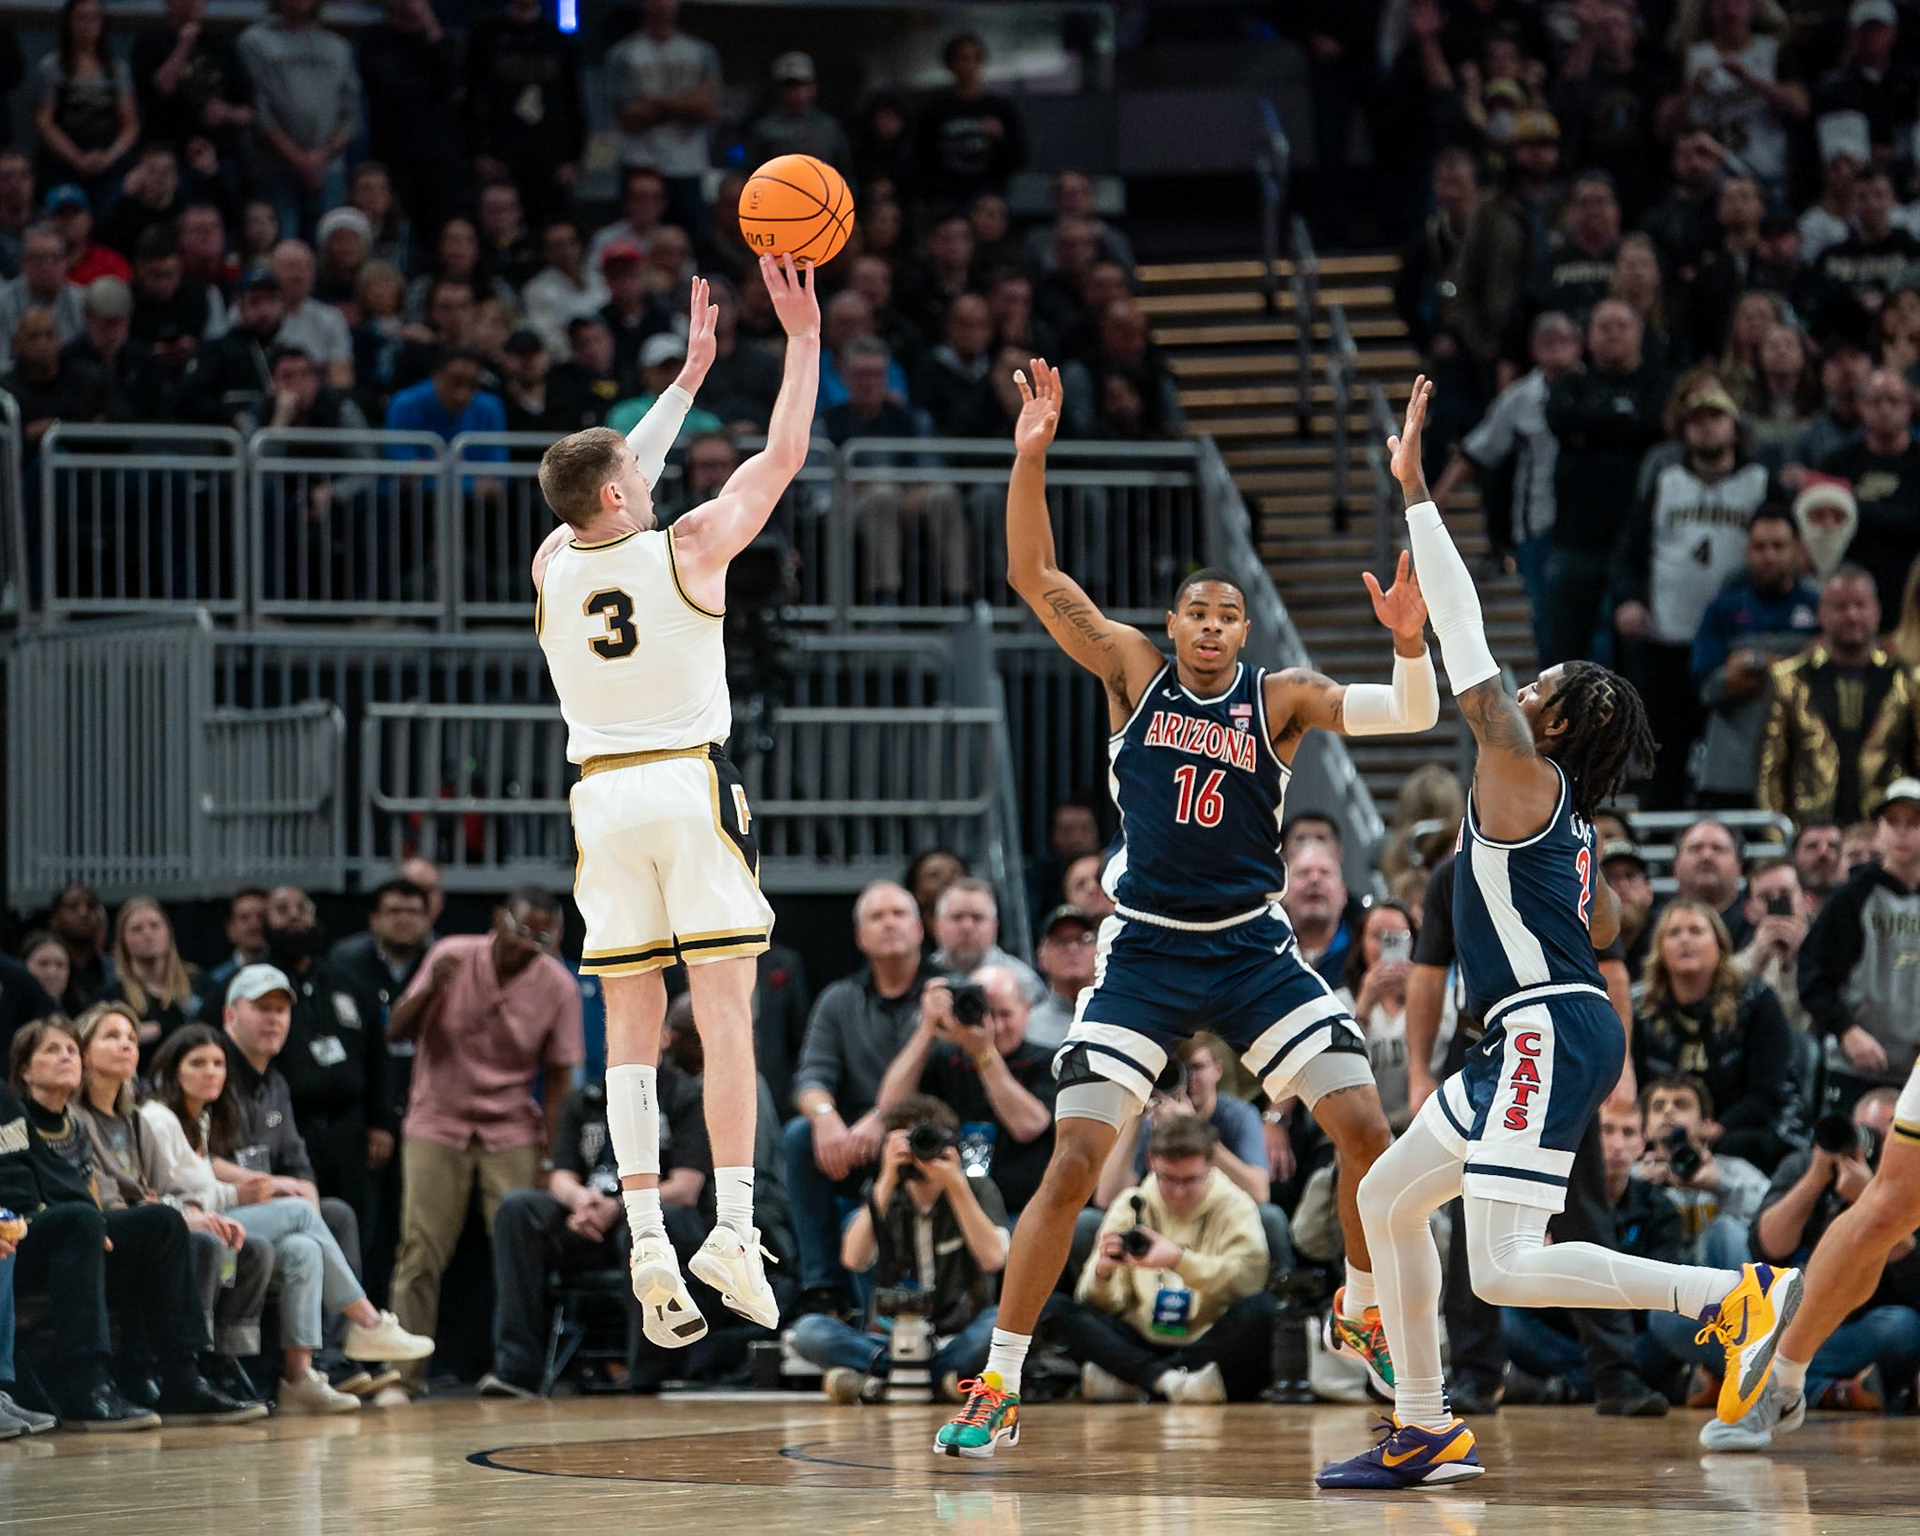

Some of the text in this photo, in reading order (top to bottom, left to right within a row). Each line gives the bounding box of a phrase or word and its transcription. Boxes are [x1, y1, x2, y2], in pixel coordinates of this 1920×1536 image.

[1691, 536, 1714, 567] 4
[582, 586, 641, 661] 3
[1143, 711, 1257, 773] ARIZONA
[730, 783, 753, 835] P
[1174, 764, 1227, 828] 16
[1575, 846, 1592, 932] 2
[1503, 1031, 1542, 1131] CATS
